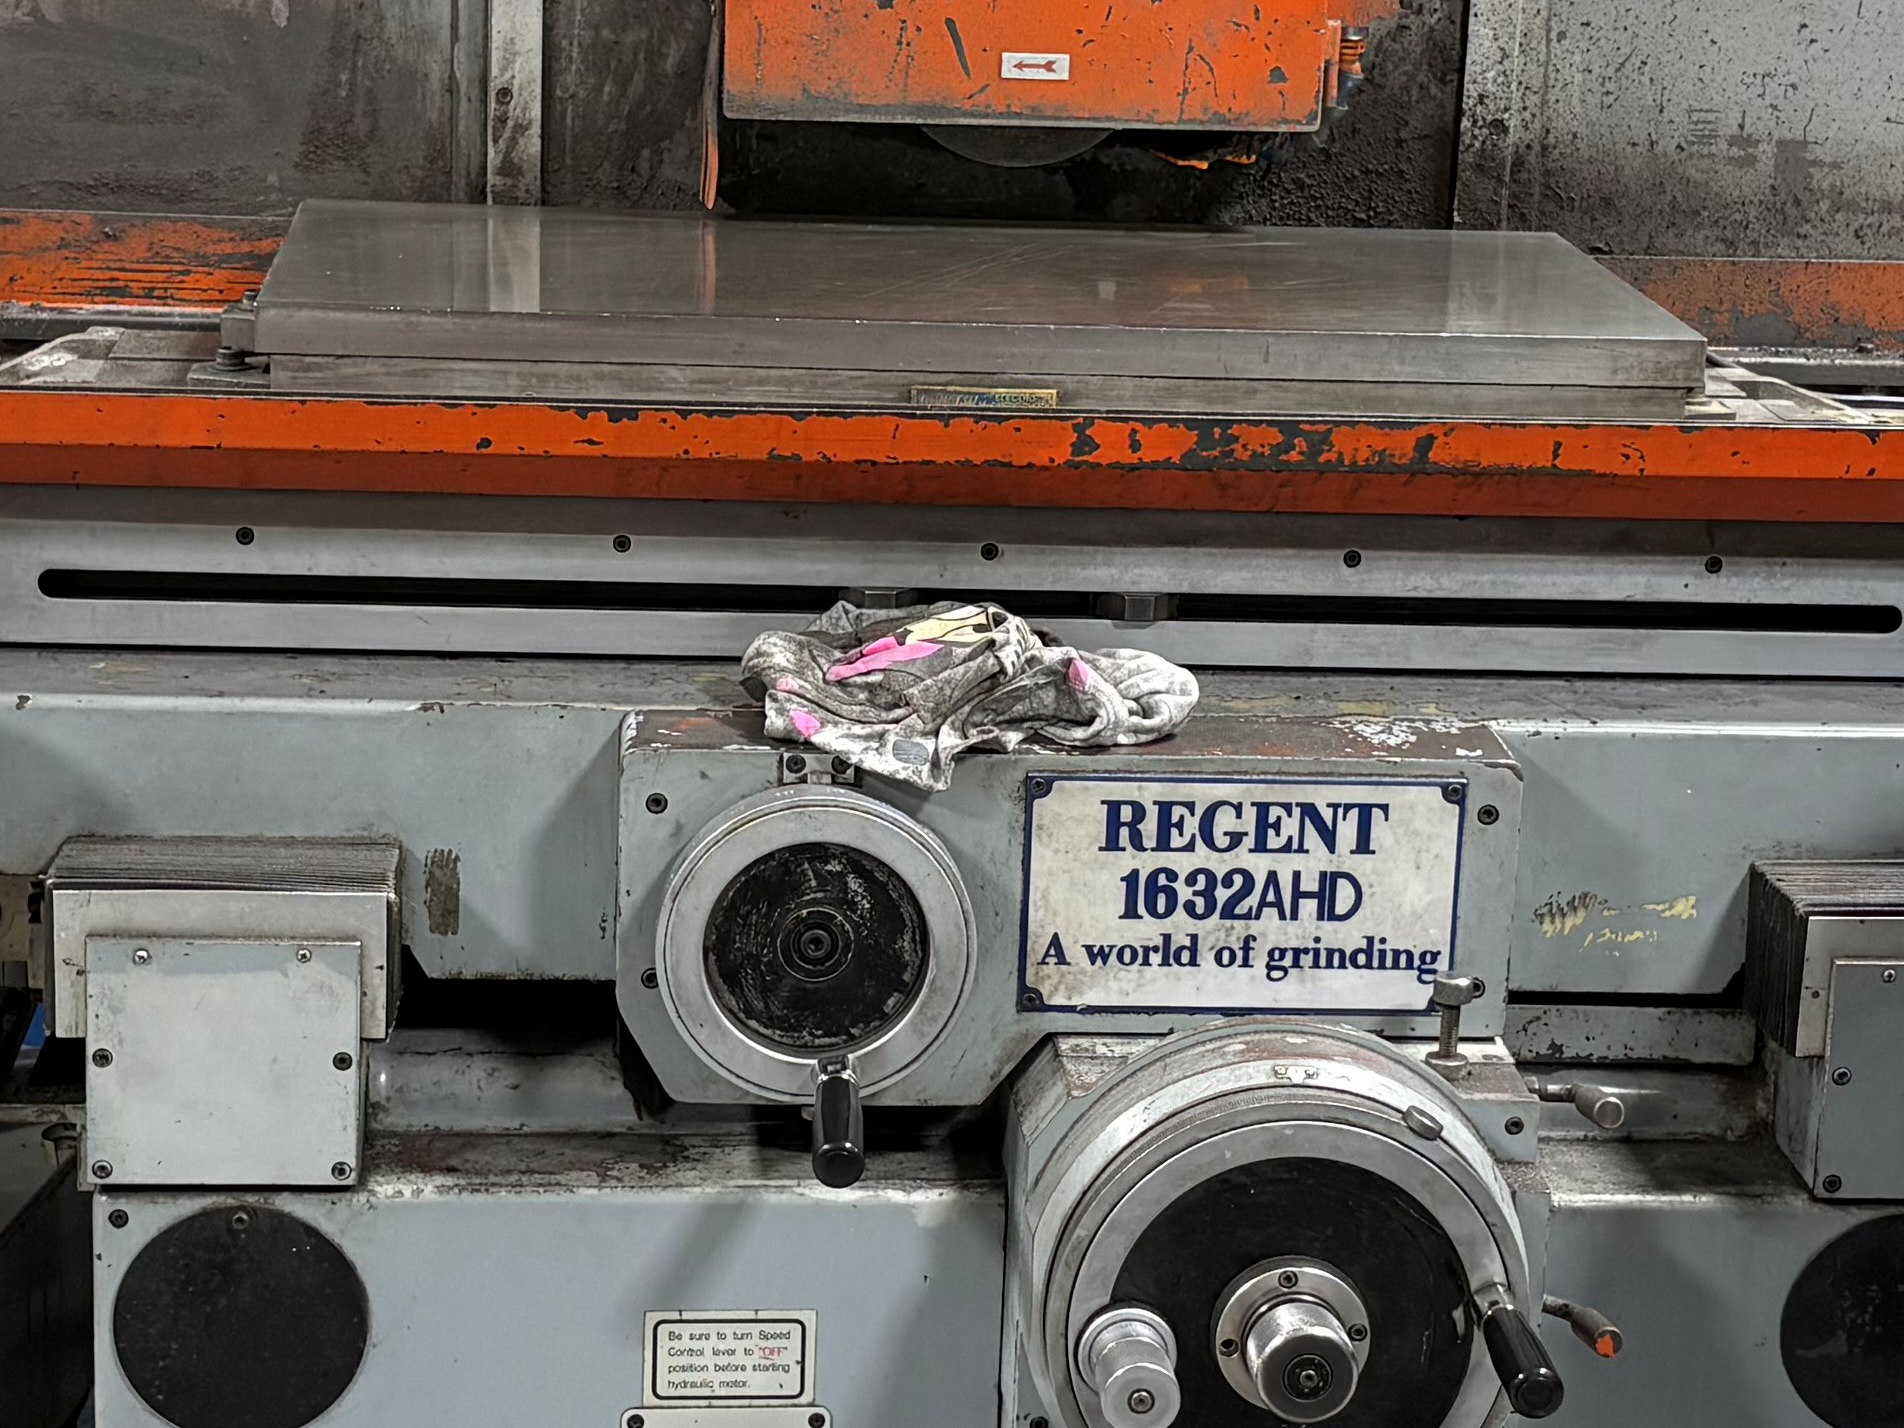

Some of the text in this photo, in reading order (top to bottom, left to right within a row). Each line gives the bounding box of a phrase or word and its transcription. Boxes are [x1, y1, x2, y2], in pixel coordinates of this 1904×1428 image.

[1098, 799, 1389, 855] REGENT
[1118, 867, 1363, 921] 1632AHD
[1036, 932, 1442, 984] A world of grinding
[668, 1330, 791, 1341] Be sure to turn Speed
[668, 1347, 705, 1357] Control
[712, 1346, 737, 1356] lever
[744, 1347, 754, 1356] to
[668, 1362, 791, 1374] position before starting
[668, 1379, 714, 1391] hydraulic
